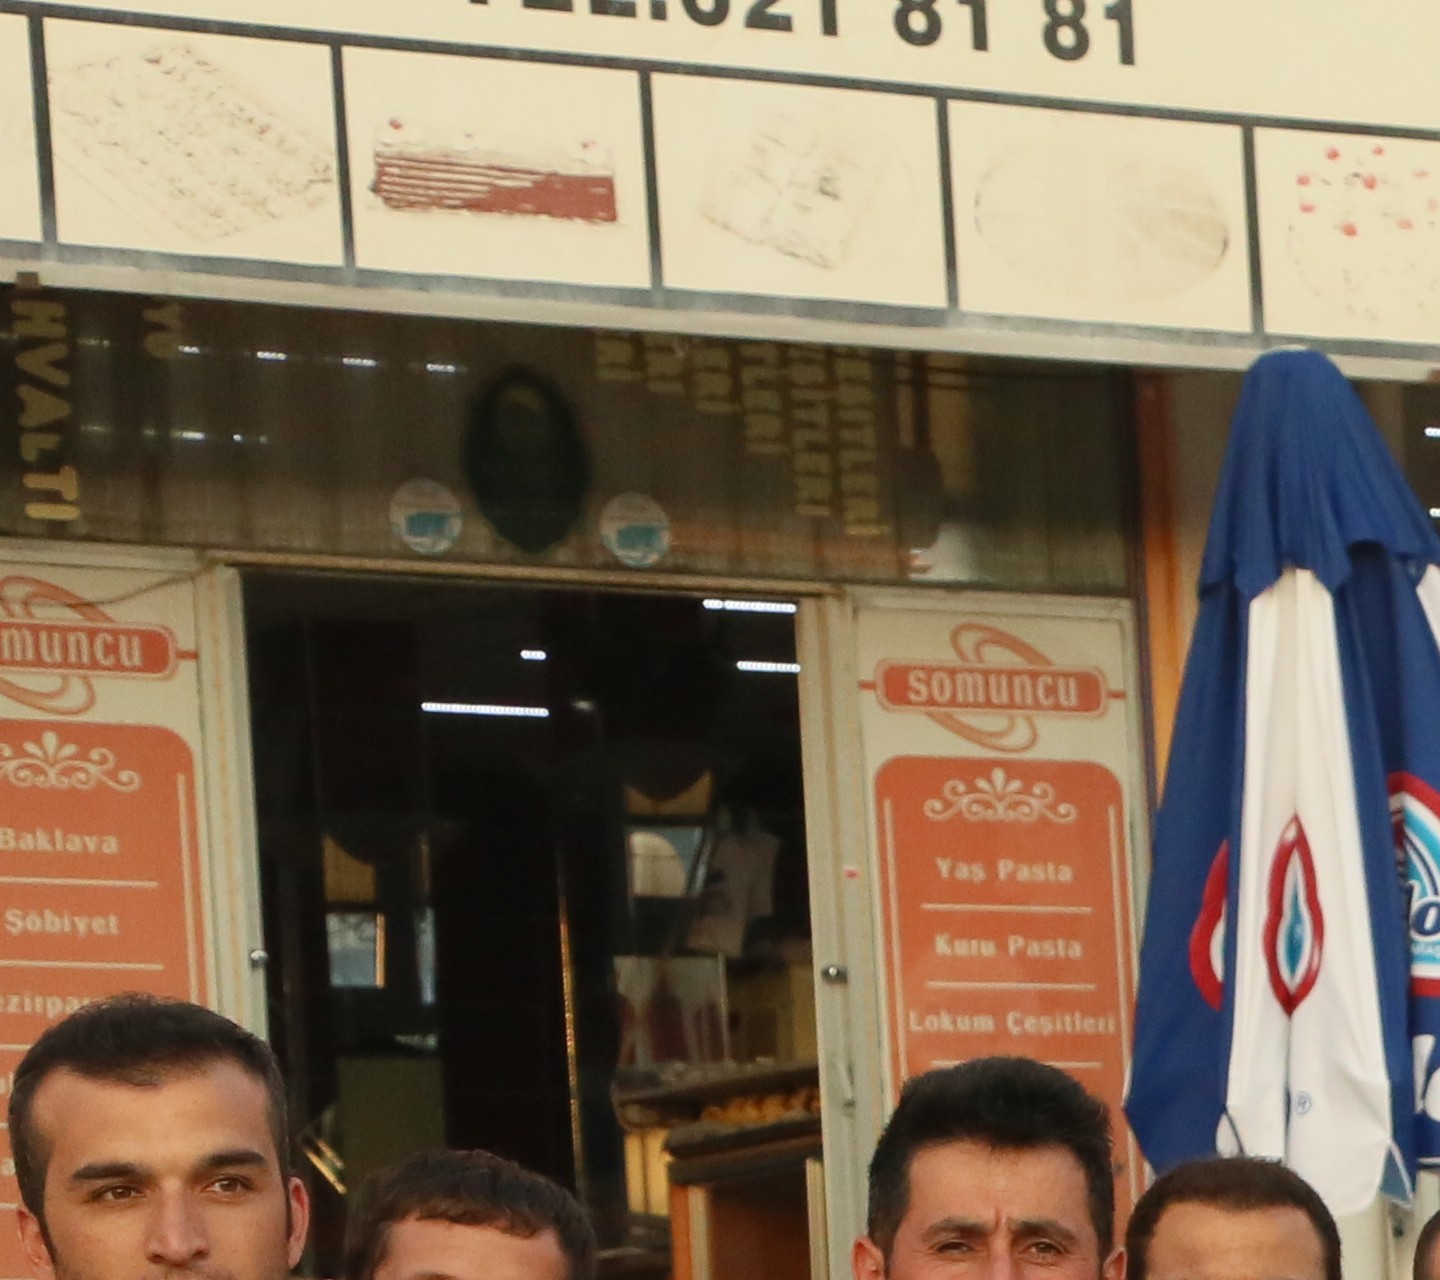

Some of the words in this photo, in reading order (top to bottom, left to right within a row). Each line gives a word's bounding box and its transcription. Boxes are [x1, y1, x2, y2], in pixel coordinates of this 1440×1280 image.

[0, 826, 121, 855] Baklava
[997, 857, 1074, 885] Pasta
[1007, 934, 1084, 962] Pasta
[909, 1009, 997, 1035] Lokum
